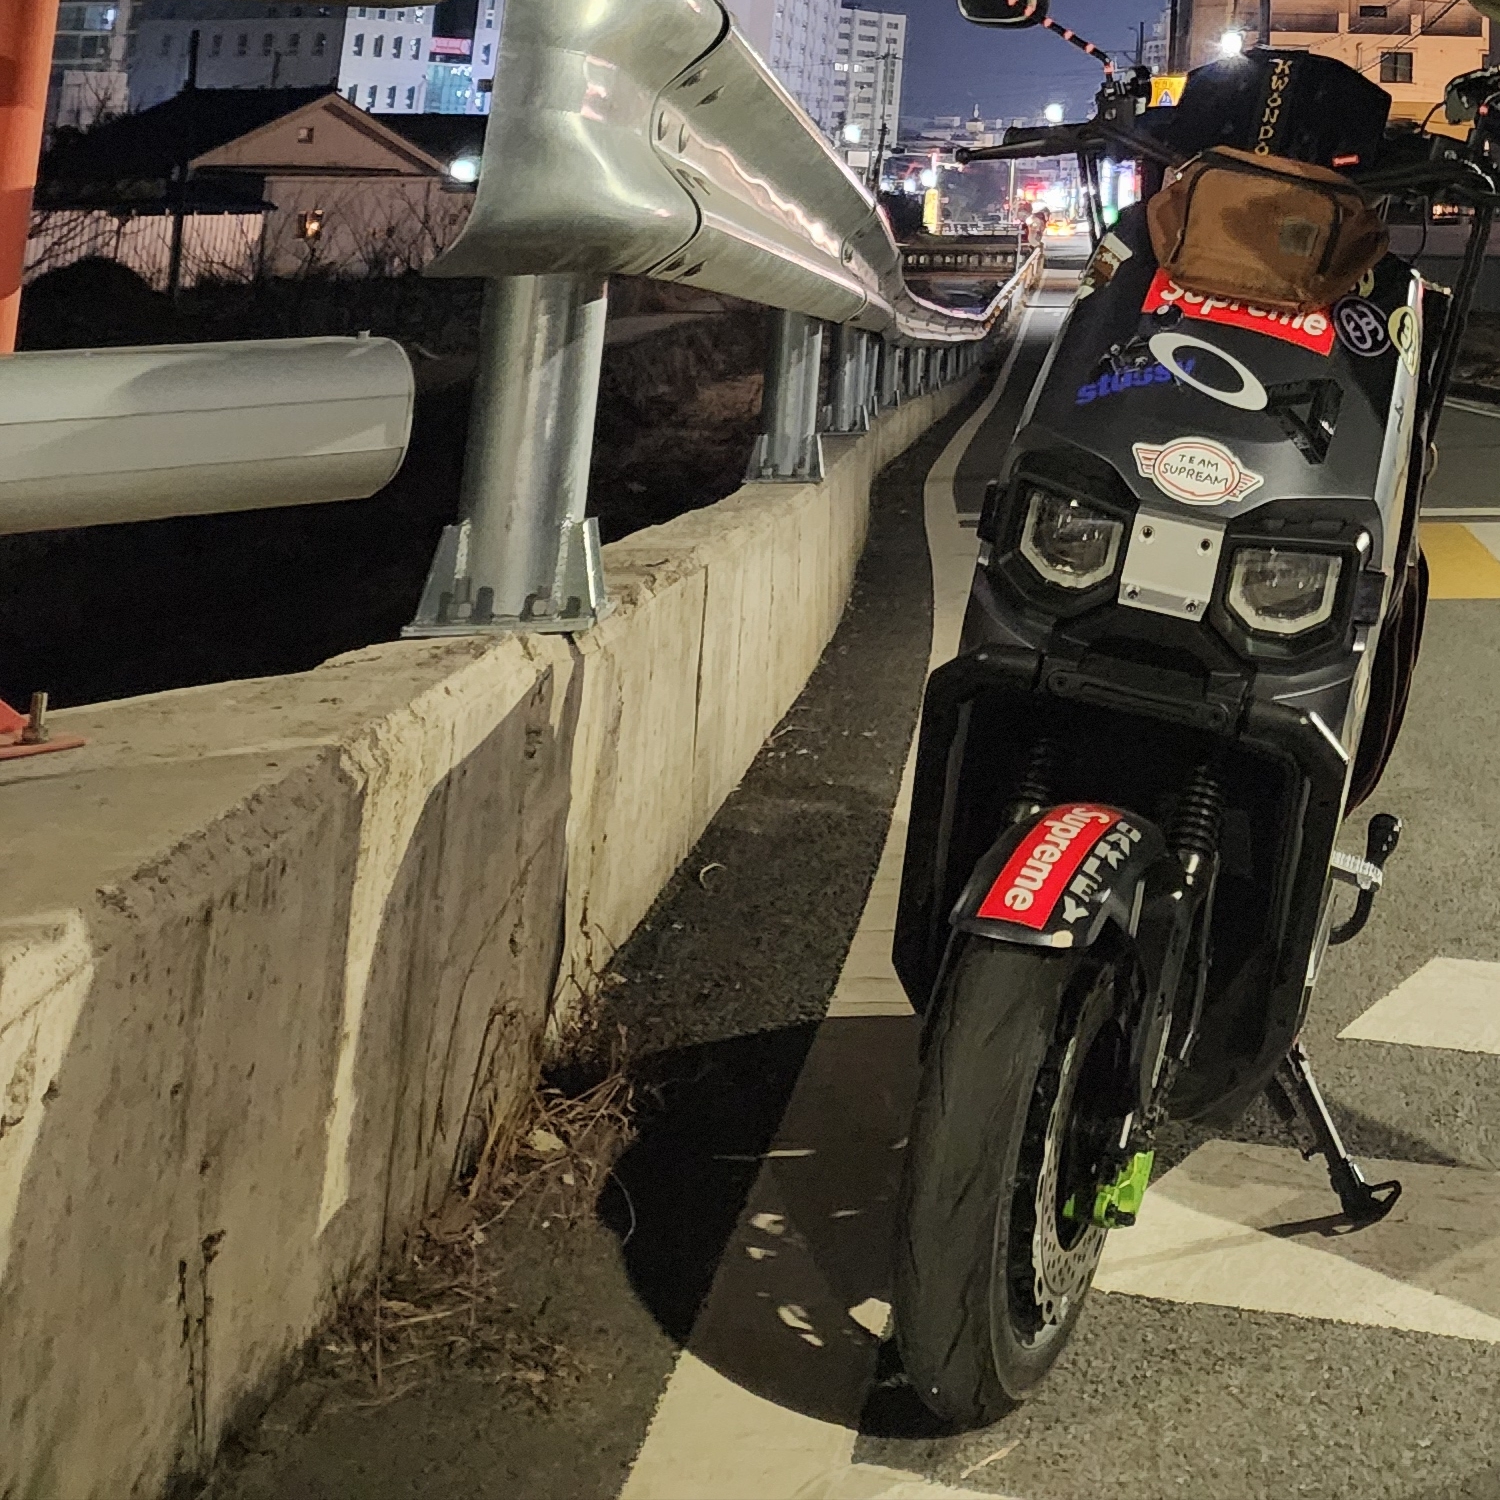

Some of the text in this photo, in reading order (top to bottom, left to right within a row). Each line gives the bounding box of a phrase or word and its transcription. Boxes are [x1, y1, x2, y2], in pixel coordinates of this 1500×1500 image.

[1161, 462, 1229, 491] SUPREAM
[1179, 454, 1219, 472] TEAM
[1004, 807, 1110, 911] Supreme
[1062, 821, 1142, 924] OAKLEY
